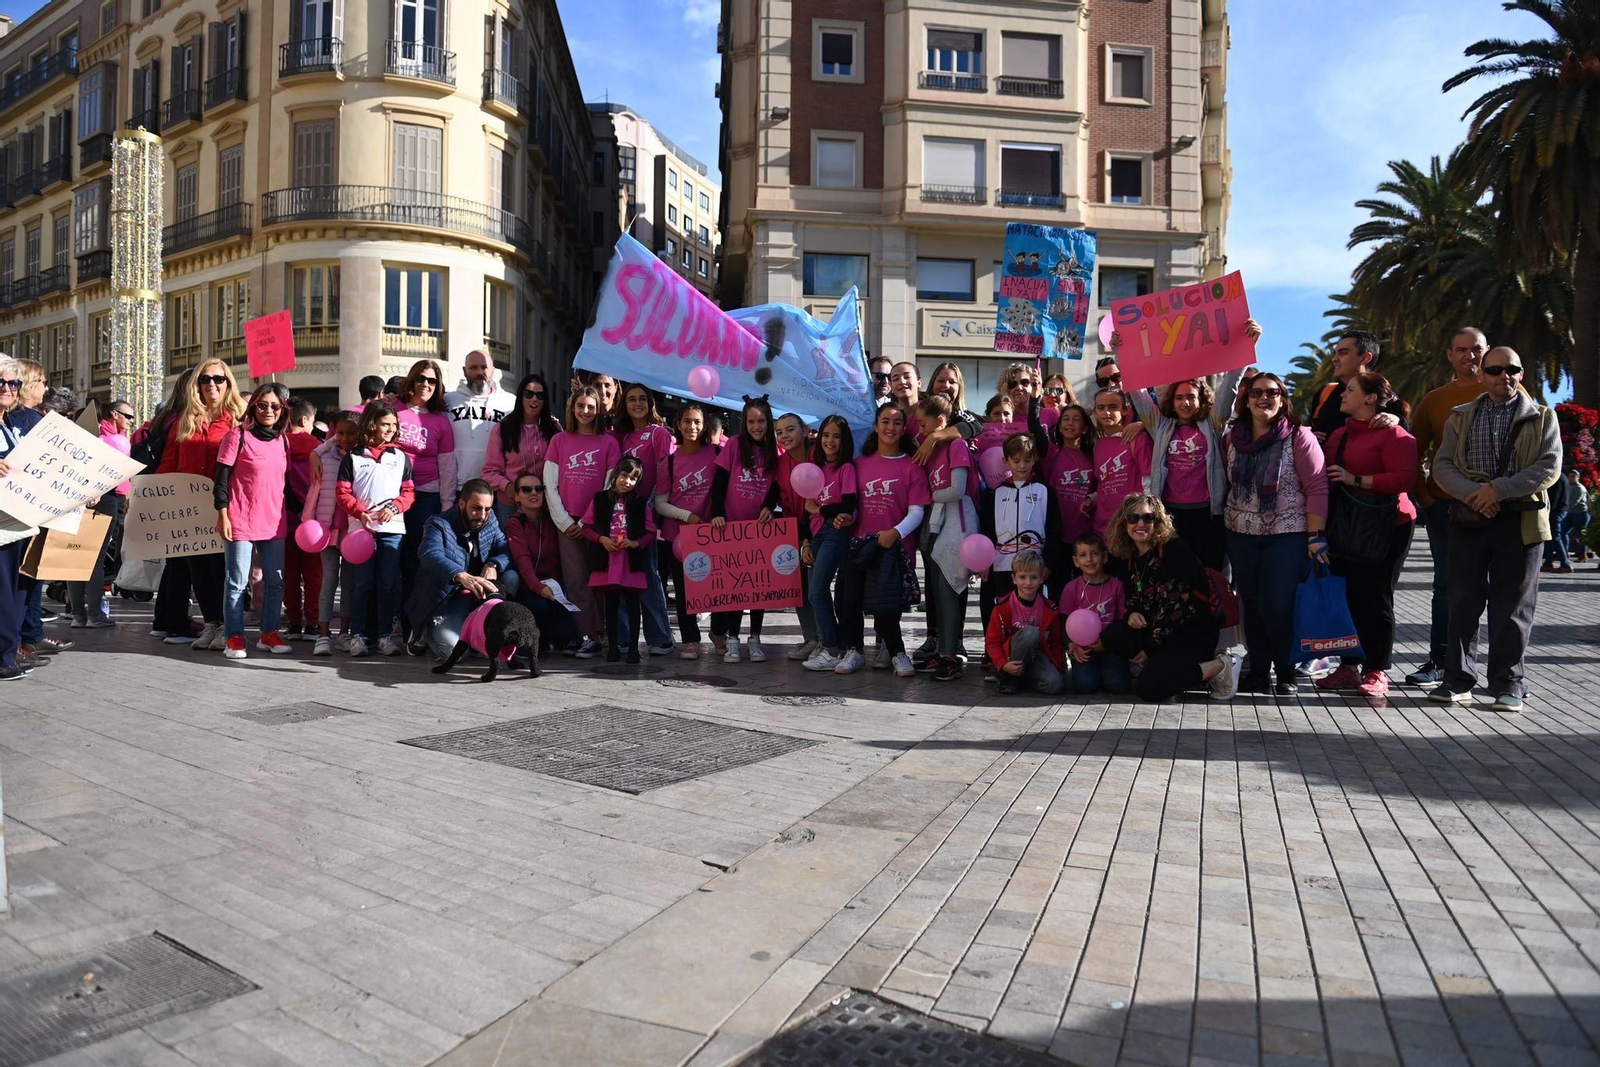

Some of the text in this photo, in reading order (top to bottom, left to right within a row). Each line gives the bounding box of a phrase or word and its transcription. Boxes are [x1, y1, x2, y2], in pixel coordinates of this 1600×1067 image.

[1002, 275, 1048, 292] INACUA
[1139, 307, 1230, 358] ¡YA!
[450, 406, 505, 423] YALE
[23, 463, 46, 480] LOS
[39, 452, 58, 466] ES
[58, 464, 90, 486] SALUD
[4, 480, 23, 495] NO
[23, 492, 36, 505] AL
[133, 483, 210, 498] ALCALDE NO
[146, 533, 160, 541] DE
[711, 548, 766, 572] INACUA
[686, 588, 801, 610] NO QUEREMOS DESAPARECER
[1314, 638, 1358, 650] edding
